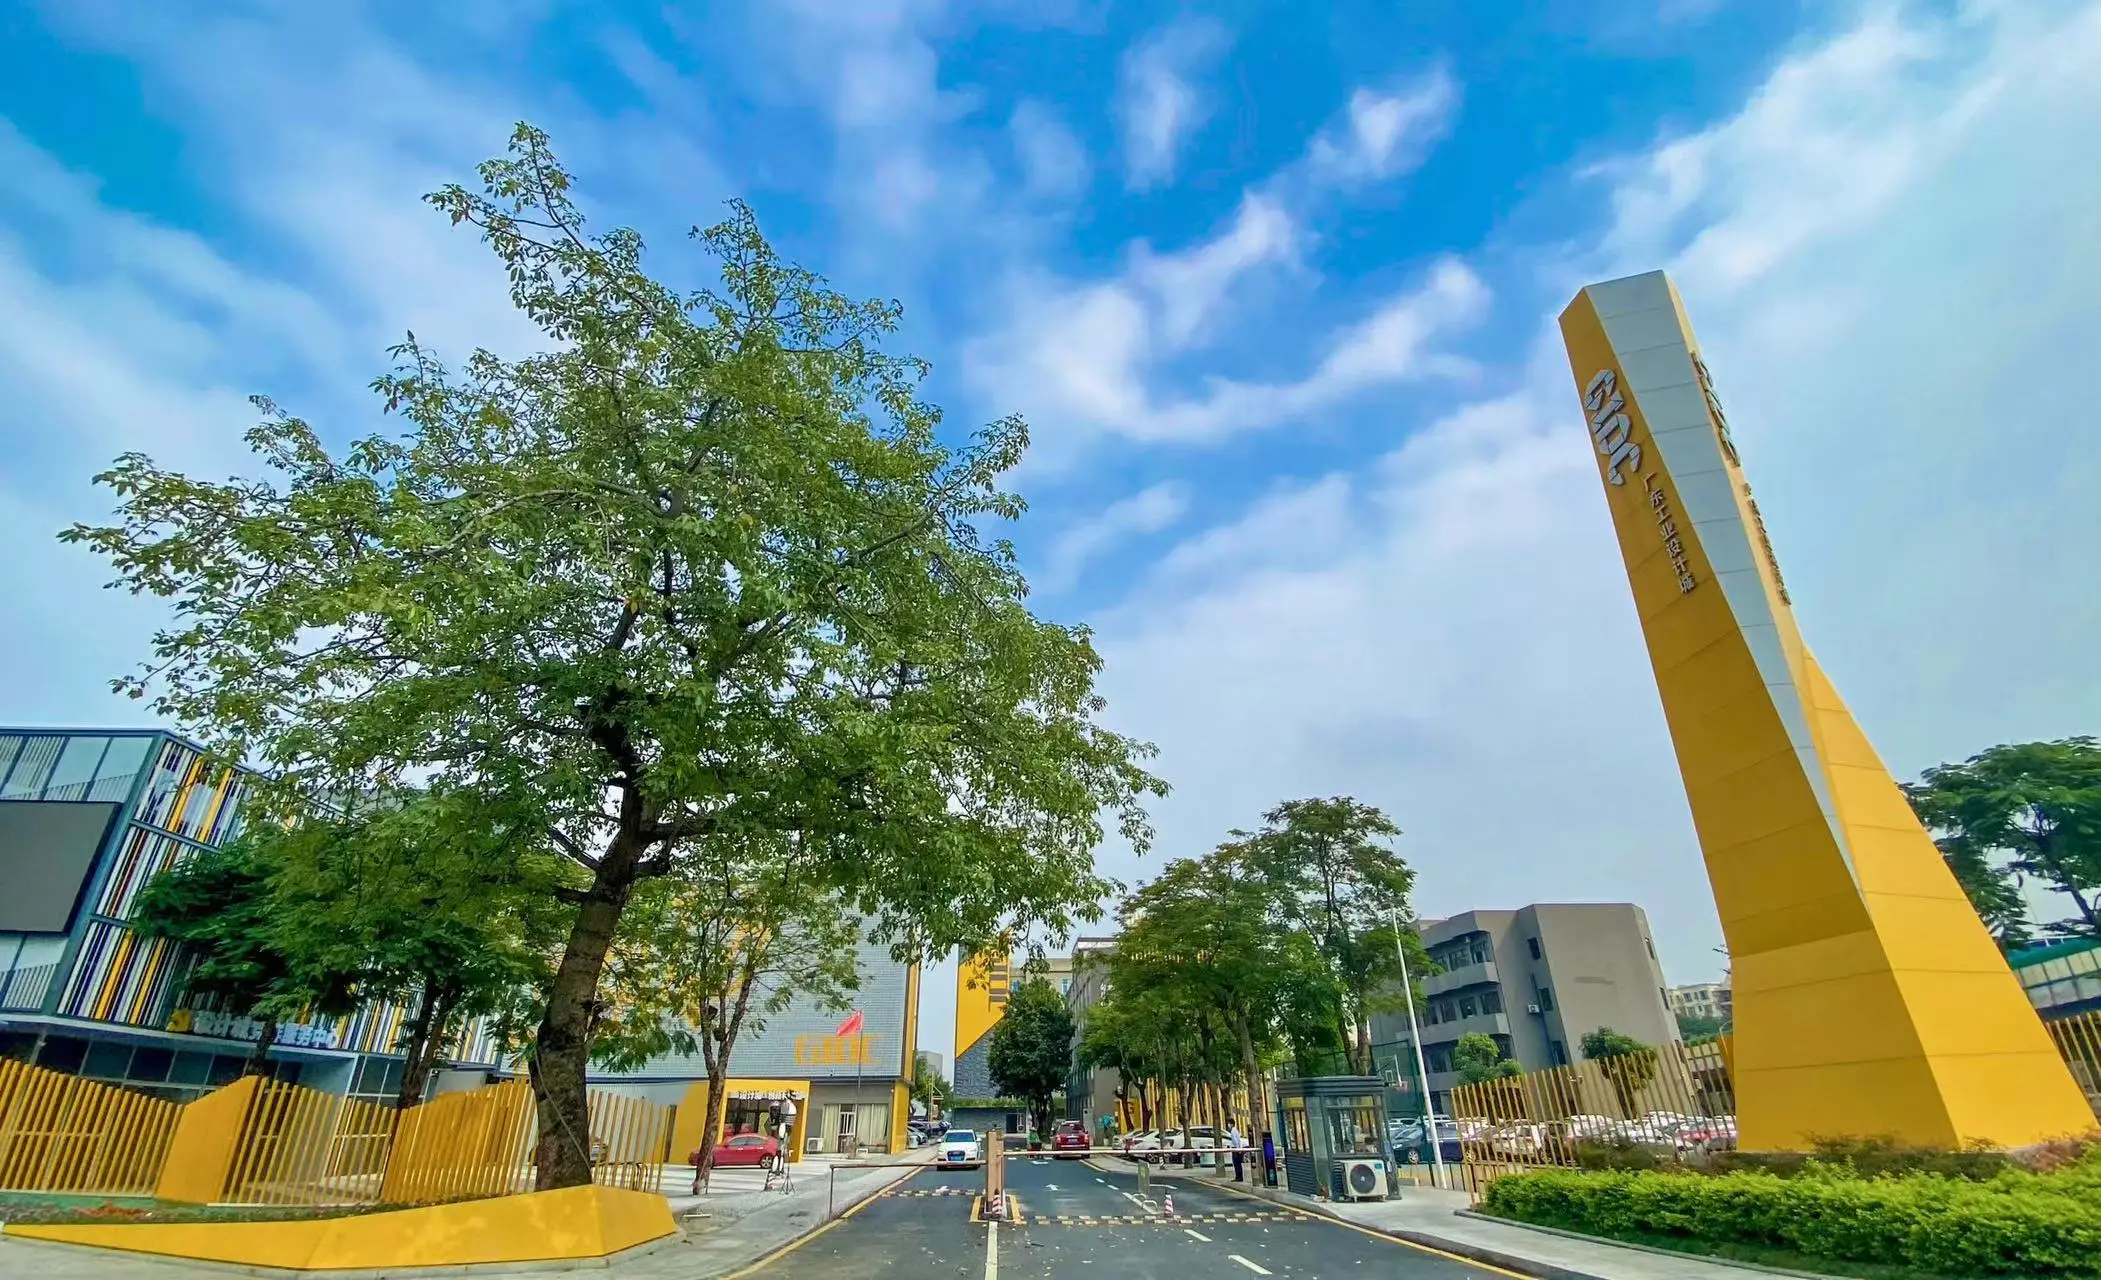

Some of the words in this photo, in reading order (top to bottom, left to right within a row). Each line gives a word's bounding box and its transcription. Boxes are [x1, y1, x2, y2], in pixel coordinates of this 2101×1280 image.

[1642, 471, 1697, 594] 广东工业设计城
